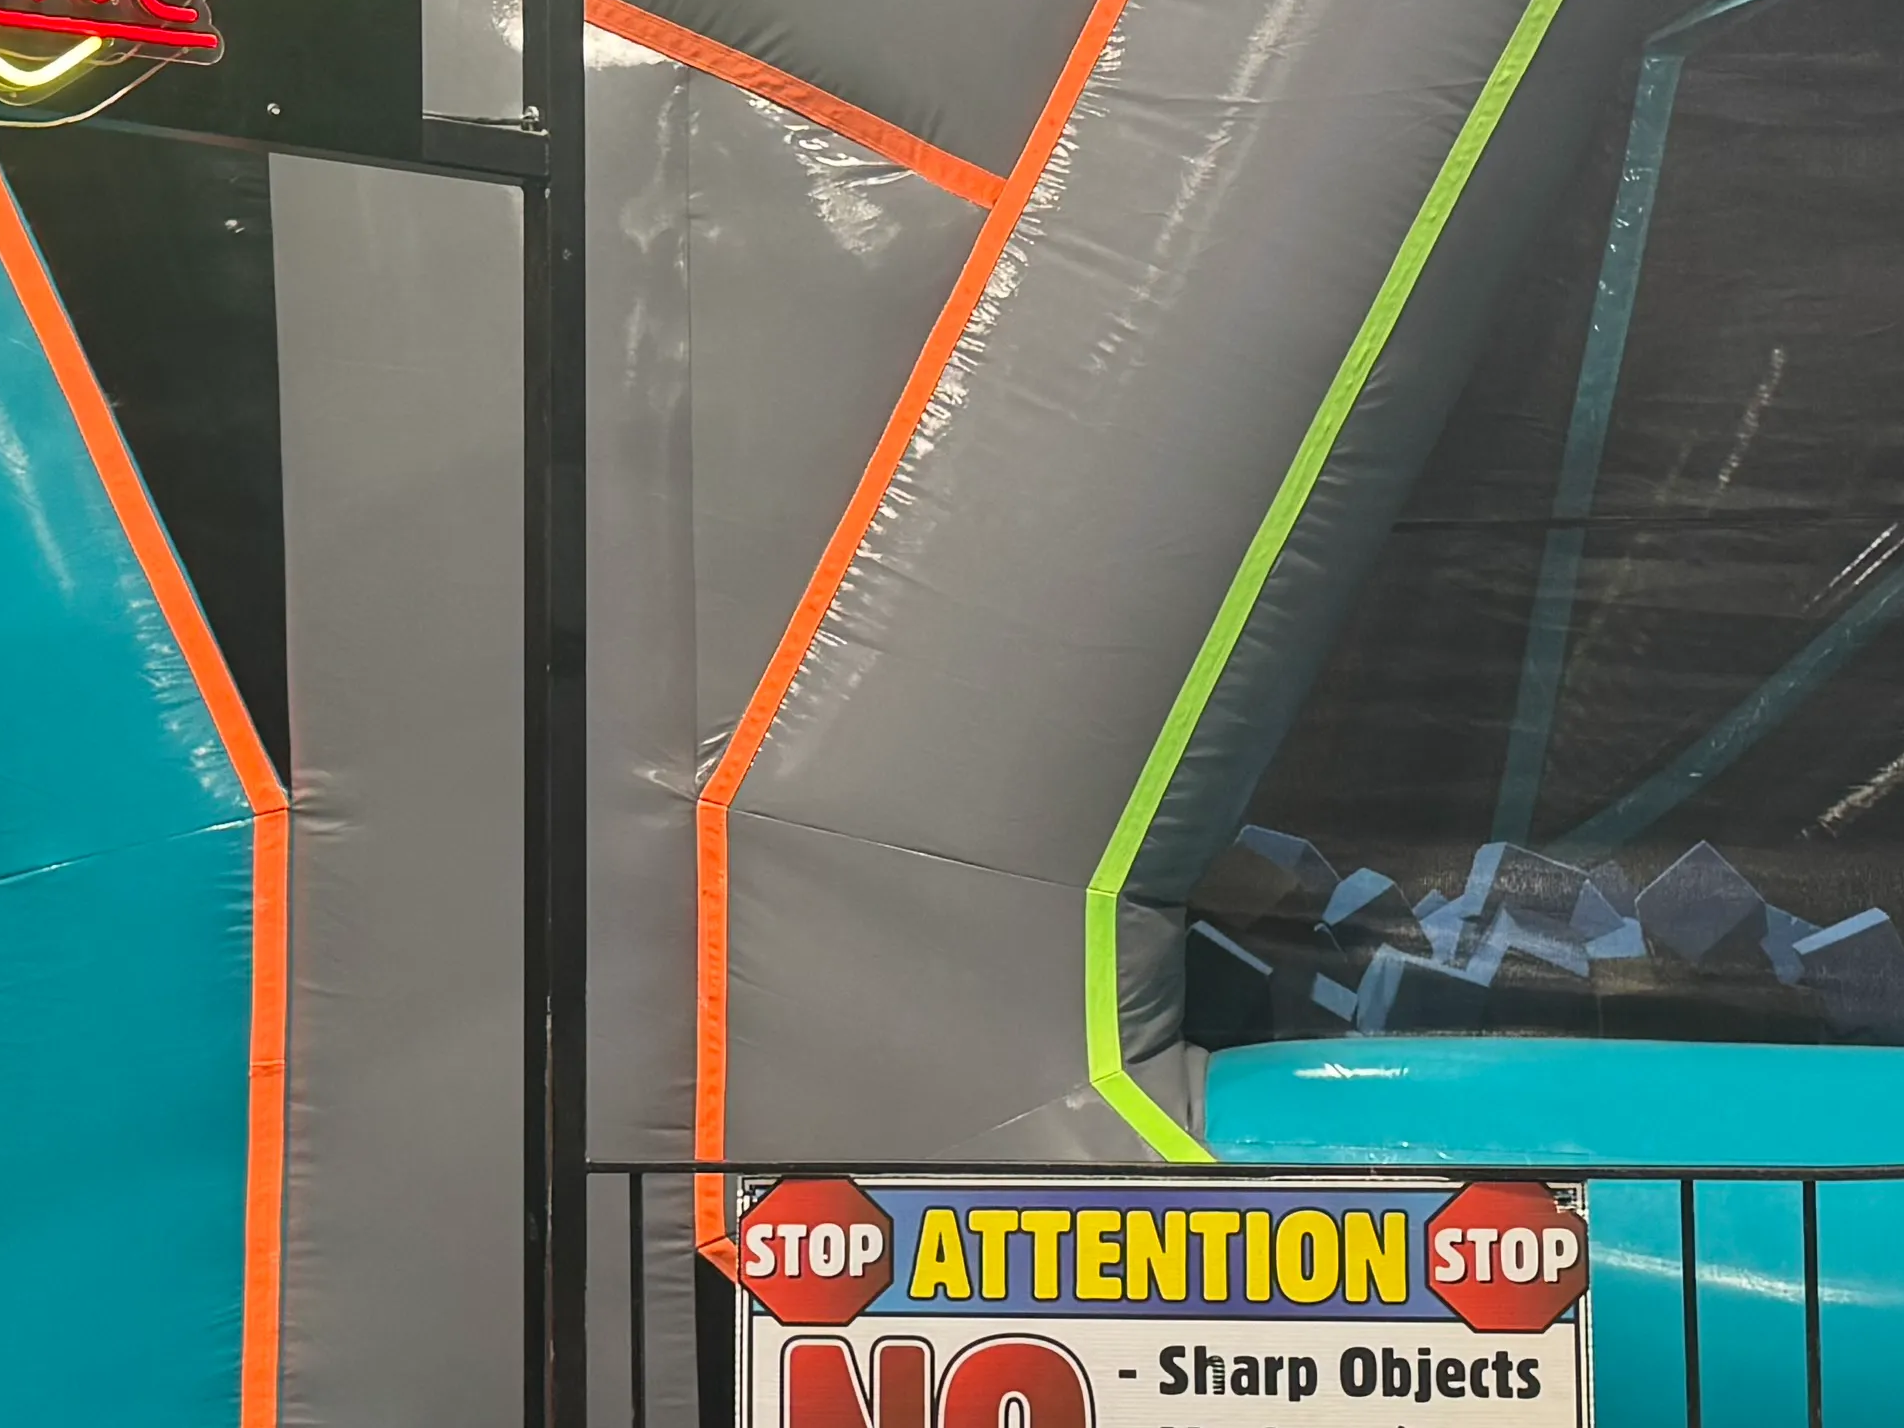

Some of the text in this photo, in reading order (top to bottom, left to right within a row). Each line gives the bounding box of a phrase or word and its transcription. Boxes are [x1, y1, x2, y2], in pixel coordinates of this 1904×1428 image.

[745, 1207, 1581, 1305] STOP ATTENTION STOP
[1158, 1345, 1319, 1401] Sharp
[1339, 1347, 1541, 1403] Objects
